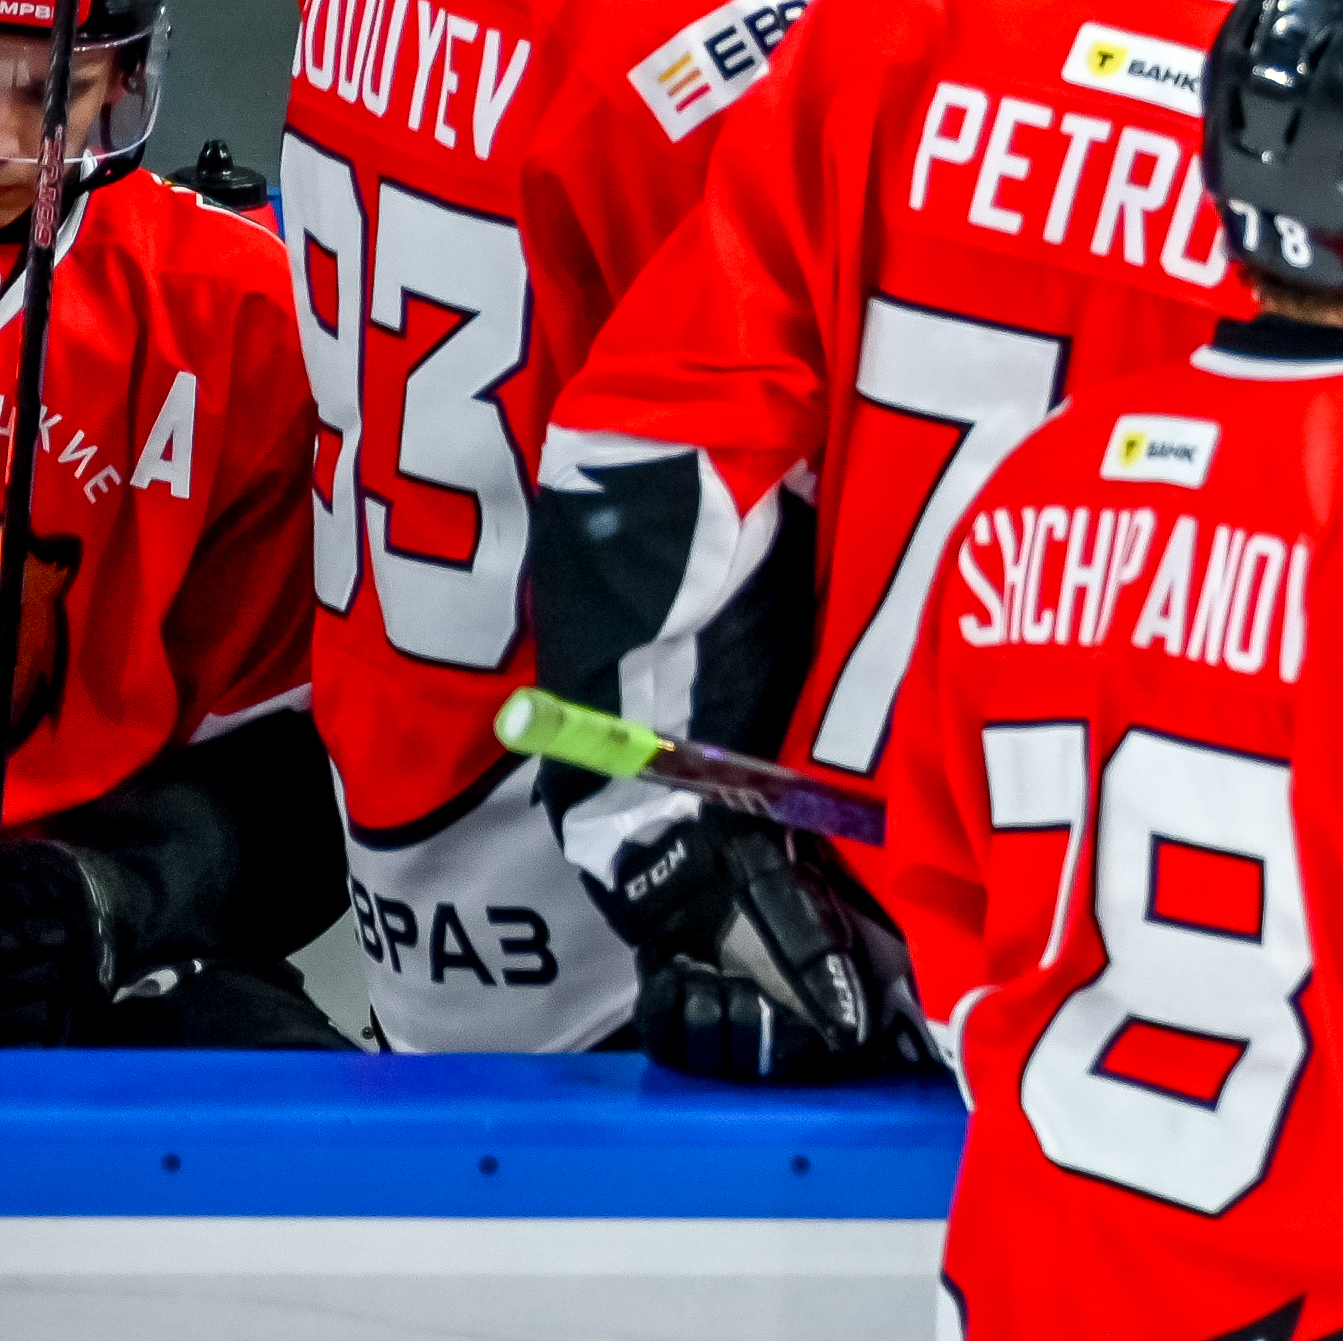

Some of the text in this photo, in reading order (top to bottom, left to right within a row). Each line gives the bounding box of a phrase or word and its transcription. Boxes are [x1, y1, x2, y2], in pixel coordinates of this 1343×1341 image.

[1229, 199, 1314, 269] 78
[129, 370, 197, 500] A
[349, 874, 559, 987] ВРАЗ
[981, 719, 1315, 1219] 78
